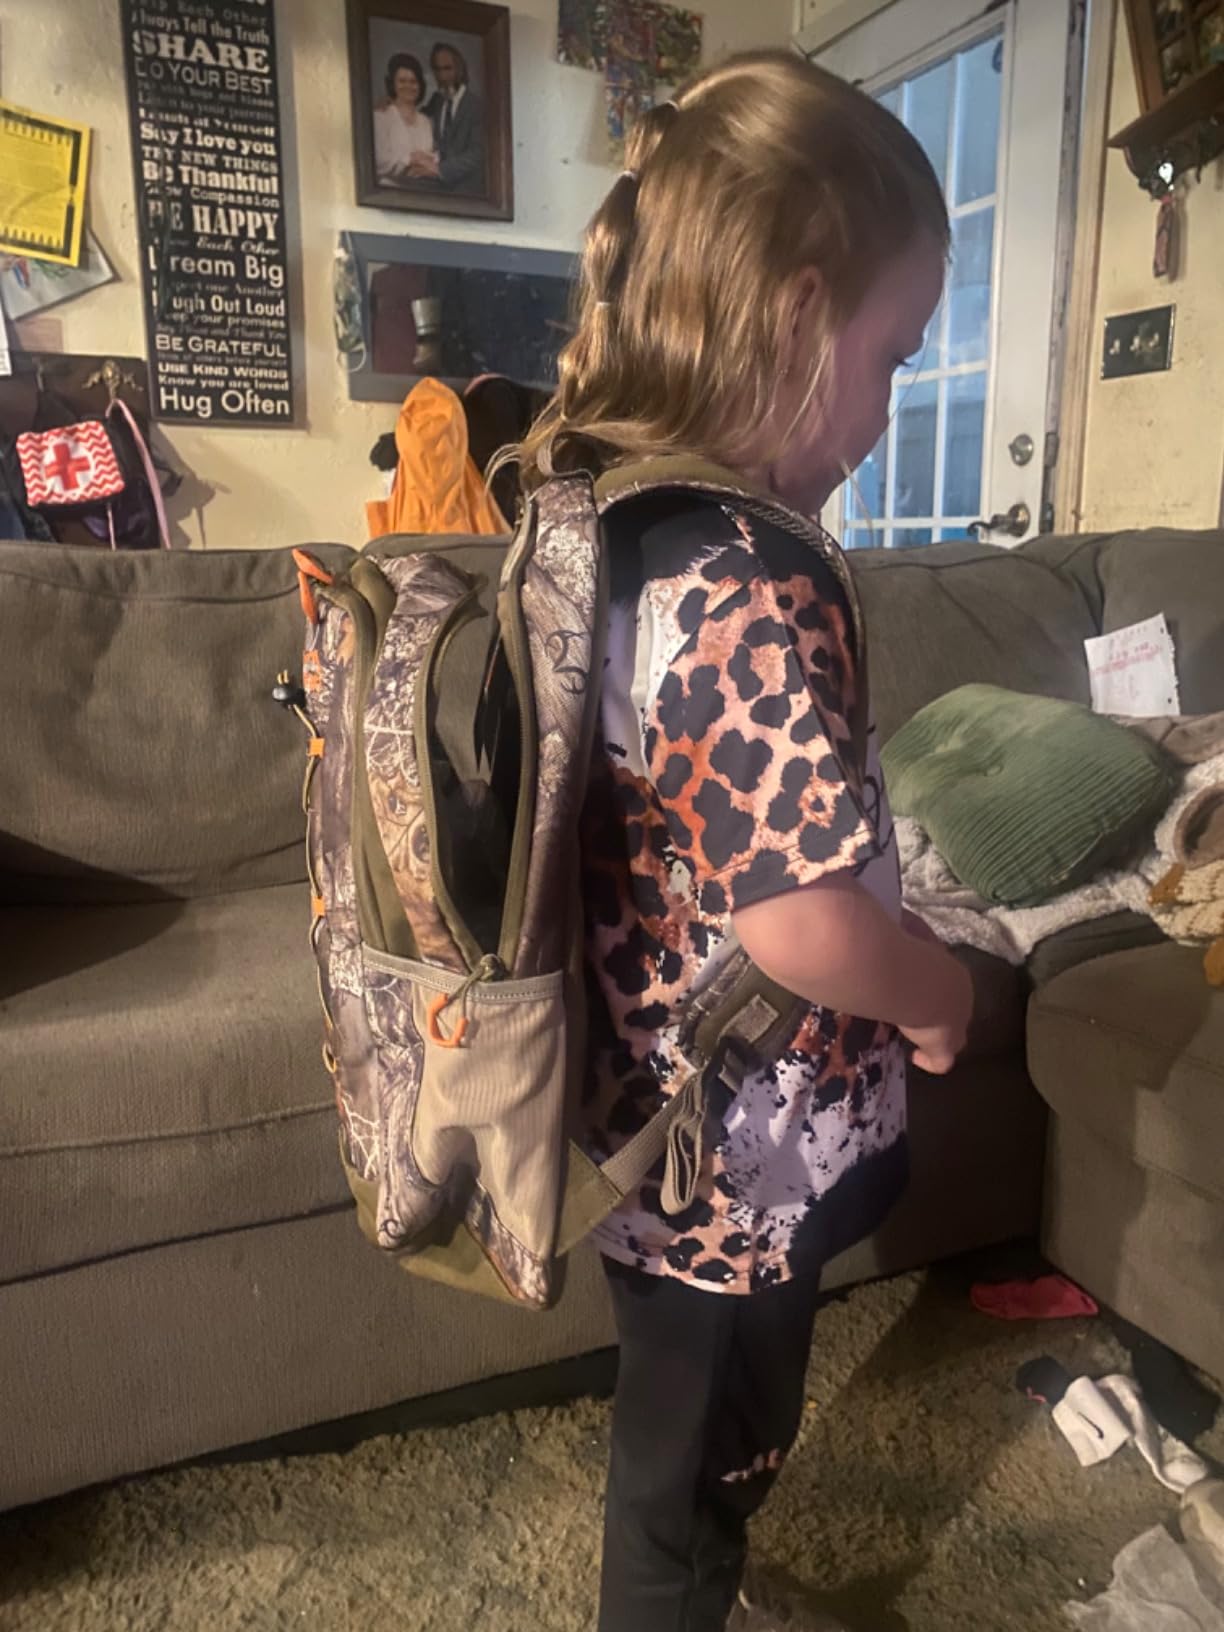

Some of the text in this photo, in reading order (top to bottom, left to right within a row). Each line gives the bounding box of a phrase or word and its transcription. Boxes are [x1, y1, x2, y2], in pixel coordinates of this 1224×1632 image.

[183, 17, 207, 35] Tell
[210, 21, 232, 39] the
[235, 25, 269, 46] Truth
[132, 30, 270, 74] SHARE
[167, 61, 220, 88] YOUR
[225, 70, 272, 95] BEST
[141, 122, 277, 156] Say I love you
[181, 150, 217, 168] NEW
[222, 154, 278, 174] THINGS
[178, 163, 279, 195] Thankful
[190, 187, 280, 208] Compassion
[191, 203, 279, 241] HAPPY
[197, 236, 234, 252] Each
[148, 246, 284, 288] ream Big
[211, 294, 240, 313] Out
[245, 297, 286, 317] Loud
[227, 316, 286, 329] promises
[155, 333, 287, 358] BE GRATEFUL
[158, 361, 288, 379] USE KIND WORDS
[158, 373, 289, 391] Know you are loved
[160, 386, 290, 418] Hug Often
